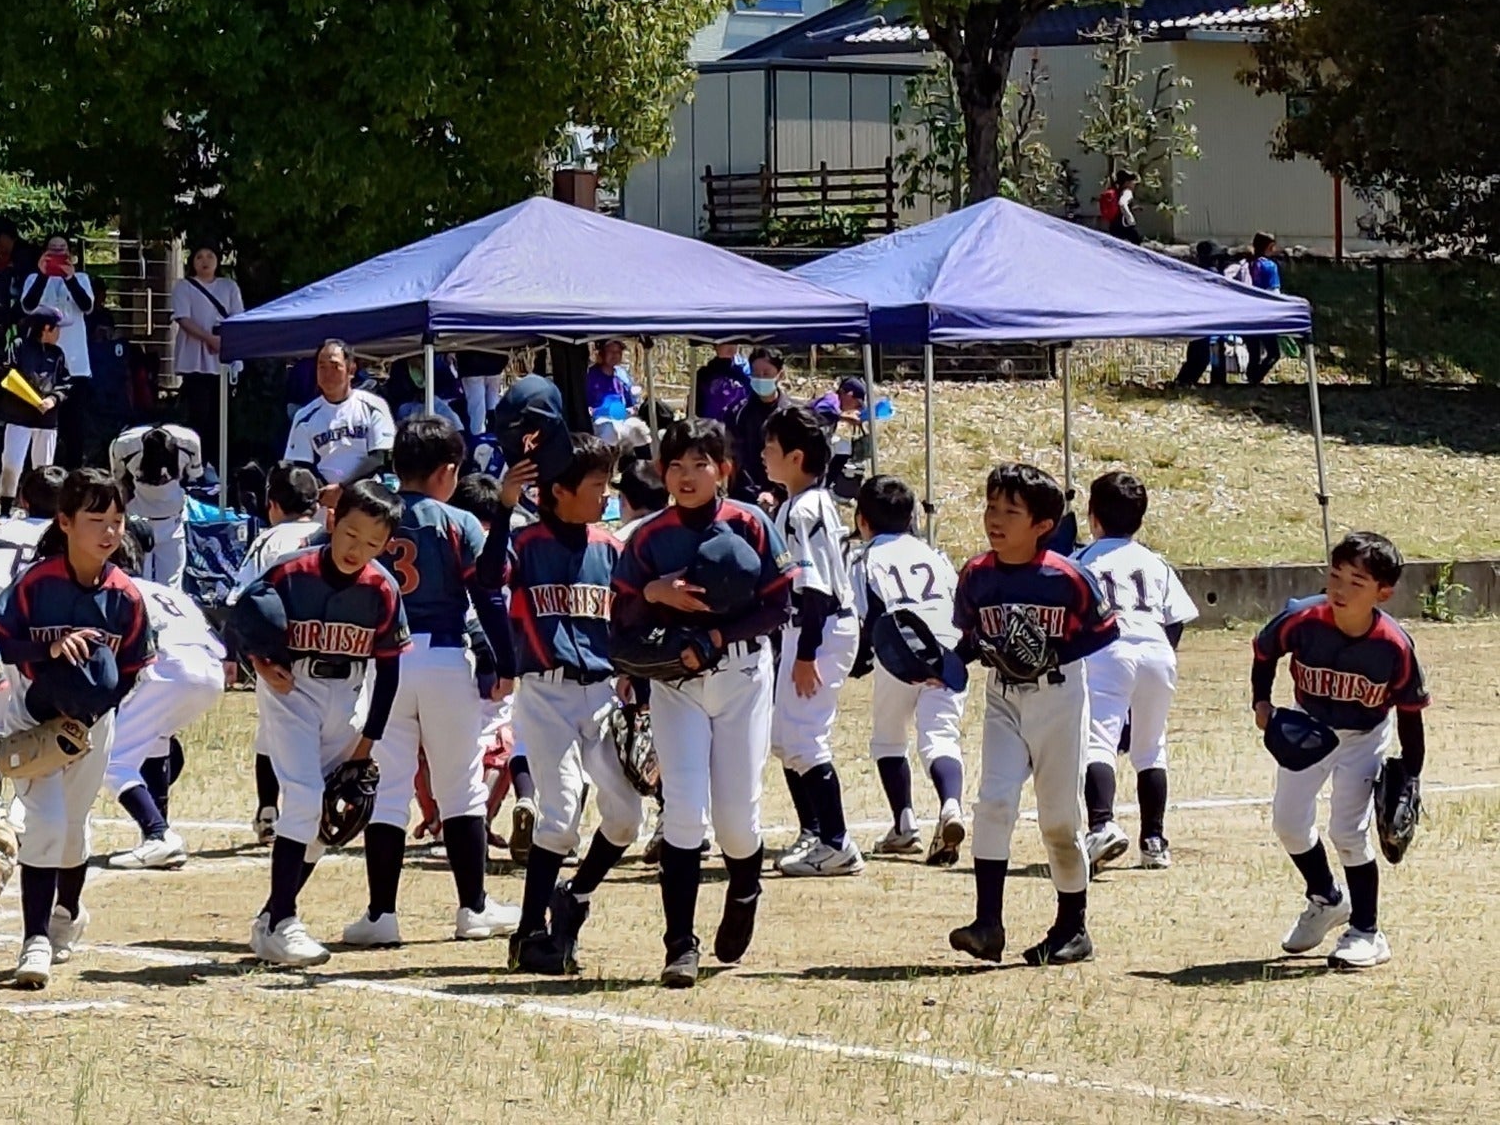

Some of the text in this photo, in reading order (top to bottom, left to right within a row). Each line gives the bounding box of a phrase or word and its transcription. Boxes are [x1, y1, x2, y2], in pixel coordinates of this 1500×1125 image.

[386, 537, 420, 596] 3
[888, 563, 944, 605] 12
[1100, 570, 1153, 612] 11
